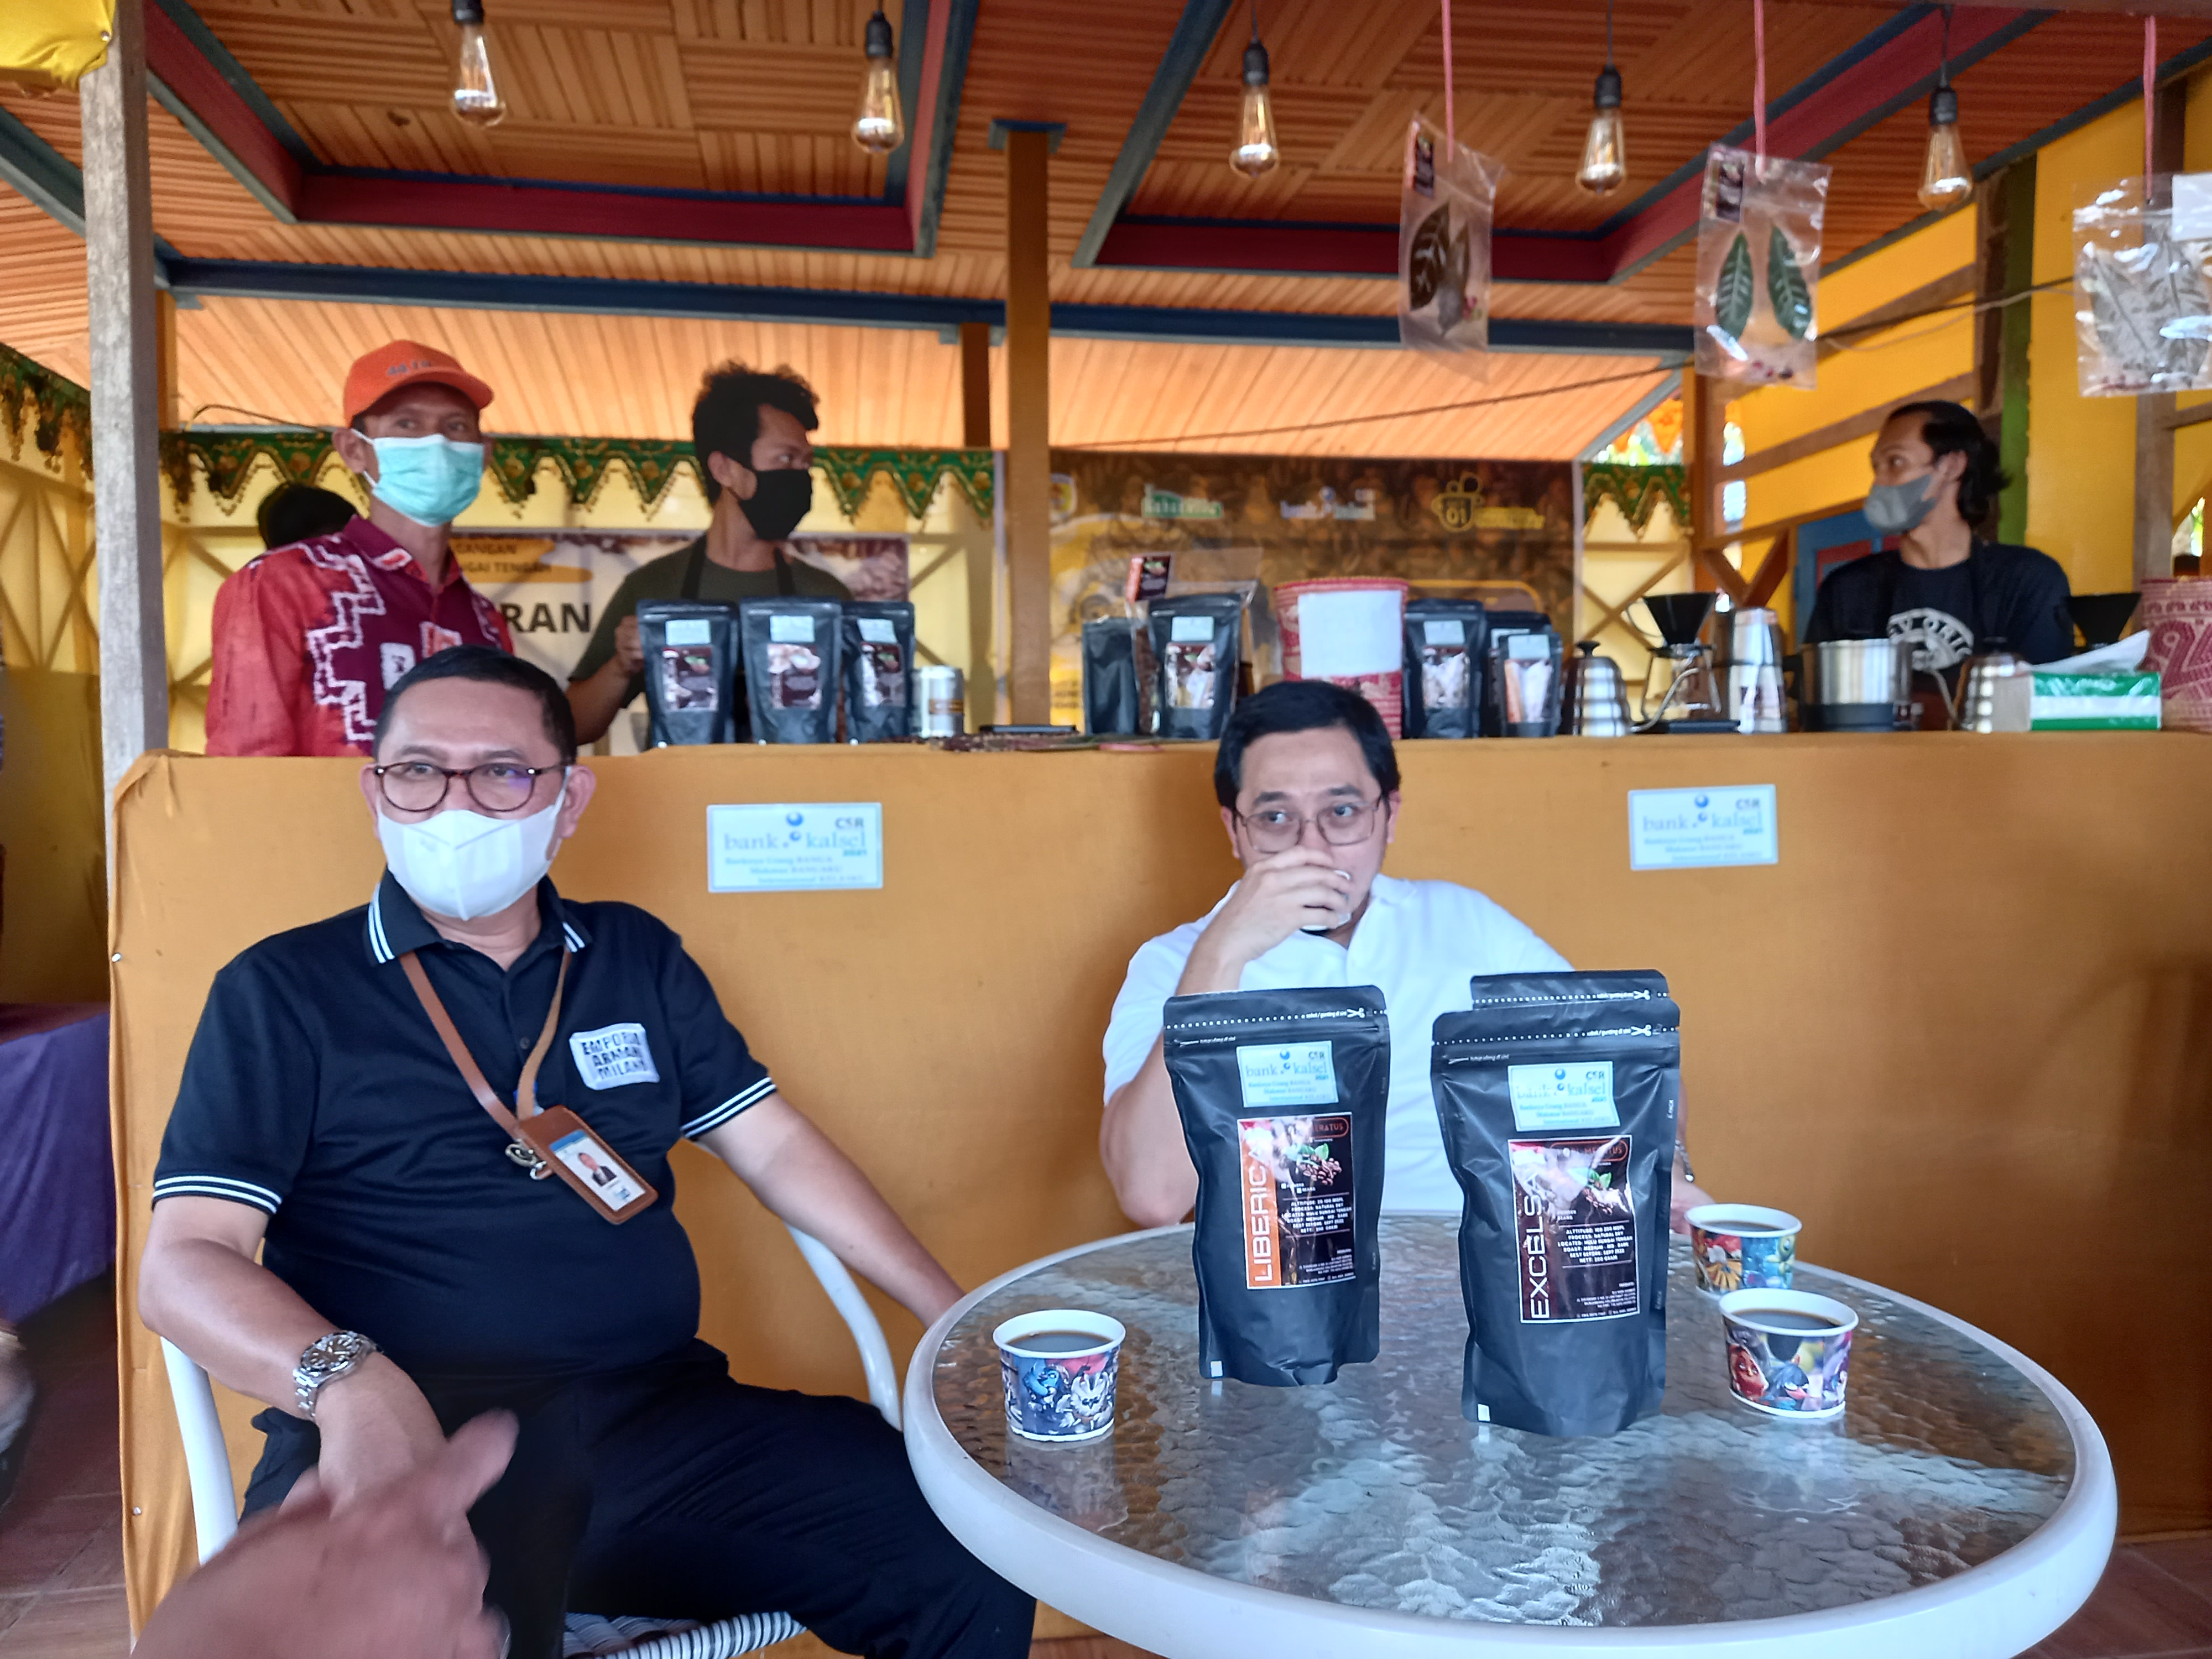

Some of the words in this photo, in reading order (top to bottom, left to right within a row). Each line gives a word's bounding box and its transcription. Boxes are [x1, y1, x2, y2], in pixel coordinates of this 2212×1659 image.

[835, 817, 864, 830] CSR
[1643, 815, 1689, 832] bank
[1711, 811, 1762, 828] kalsel
[724, 832, 778, 851] bank
[806, 831, 866, 849] kalsel
[1308, 1051, 1324, 1060] CSR
[1245, 1064, 1279, 1077] bank
[1293, 1061, 1328, 1074] kalsel
[1586, 1071, 1604, 1080] CSR
[1567, 1082, 1606, 1095] kalsel
[1313, 1123, 1344, 1132] ERATUS
